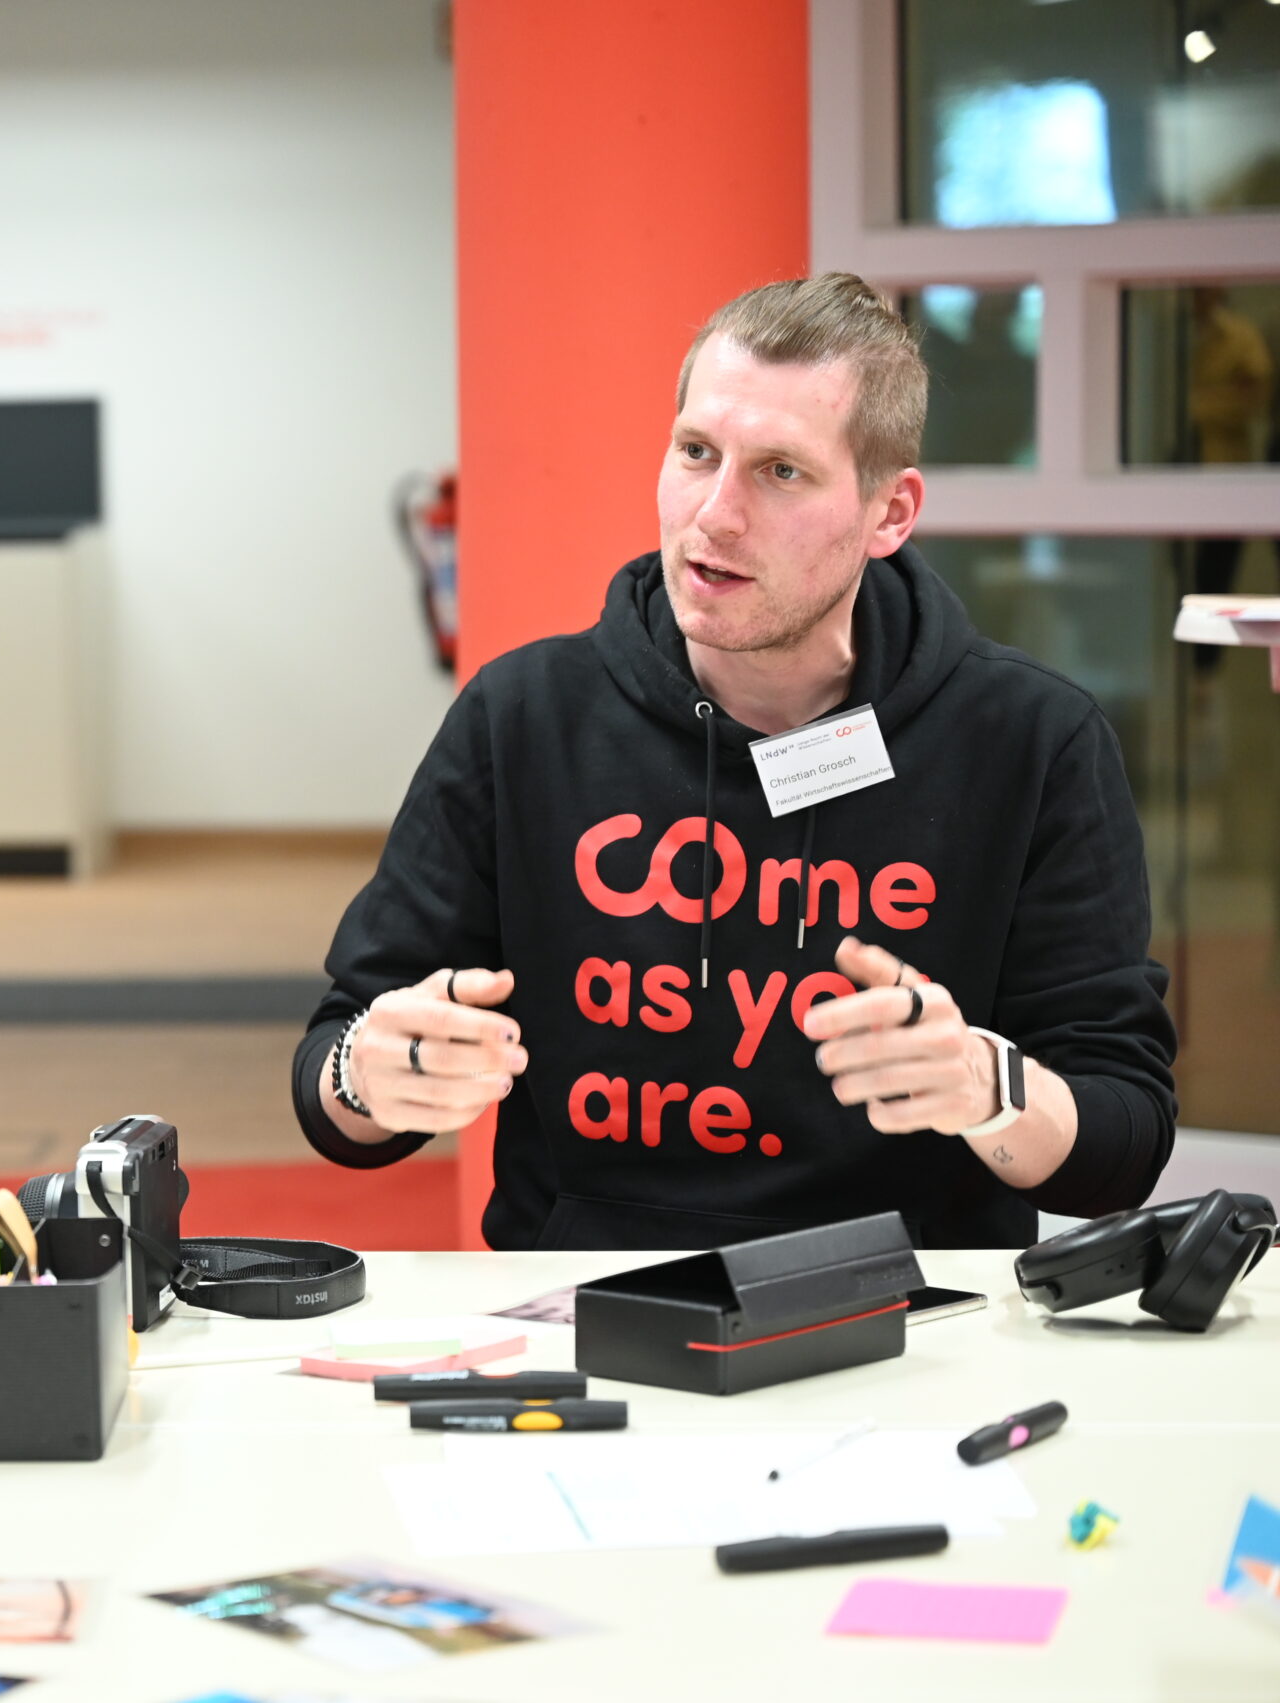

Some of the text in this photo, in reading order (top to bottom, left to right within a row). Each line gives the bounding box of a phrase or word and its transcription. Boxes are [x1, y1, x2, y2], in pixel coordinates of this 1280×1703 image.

[769, 755, 857, 789] Christian Grosch
[775, 766, 892, 807] Fakultät Wirtschaftswissenschaften
[575, 957, 900, 1069] as yo
[568, 1071, 782, 1157] are.
[295, 1290, 329, 1305] instax
